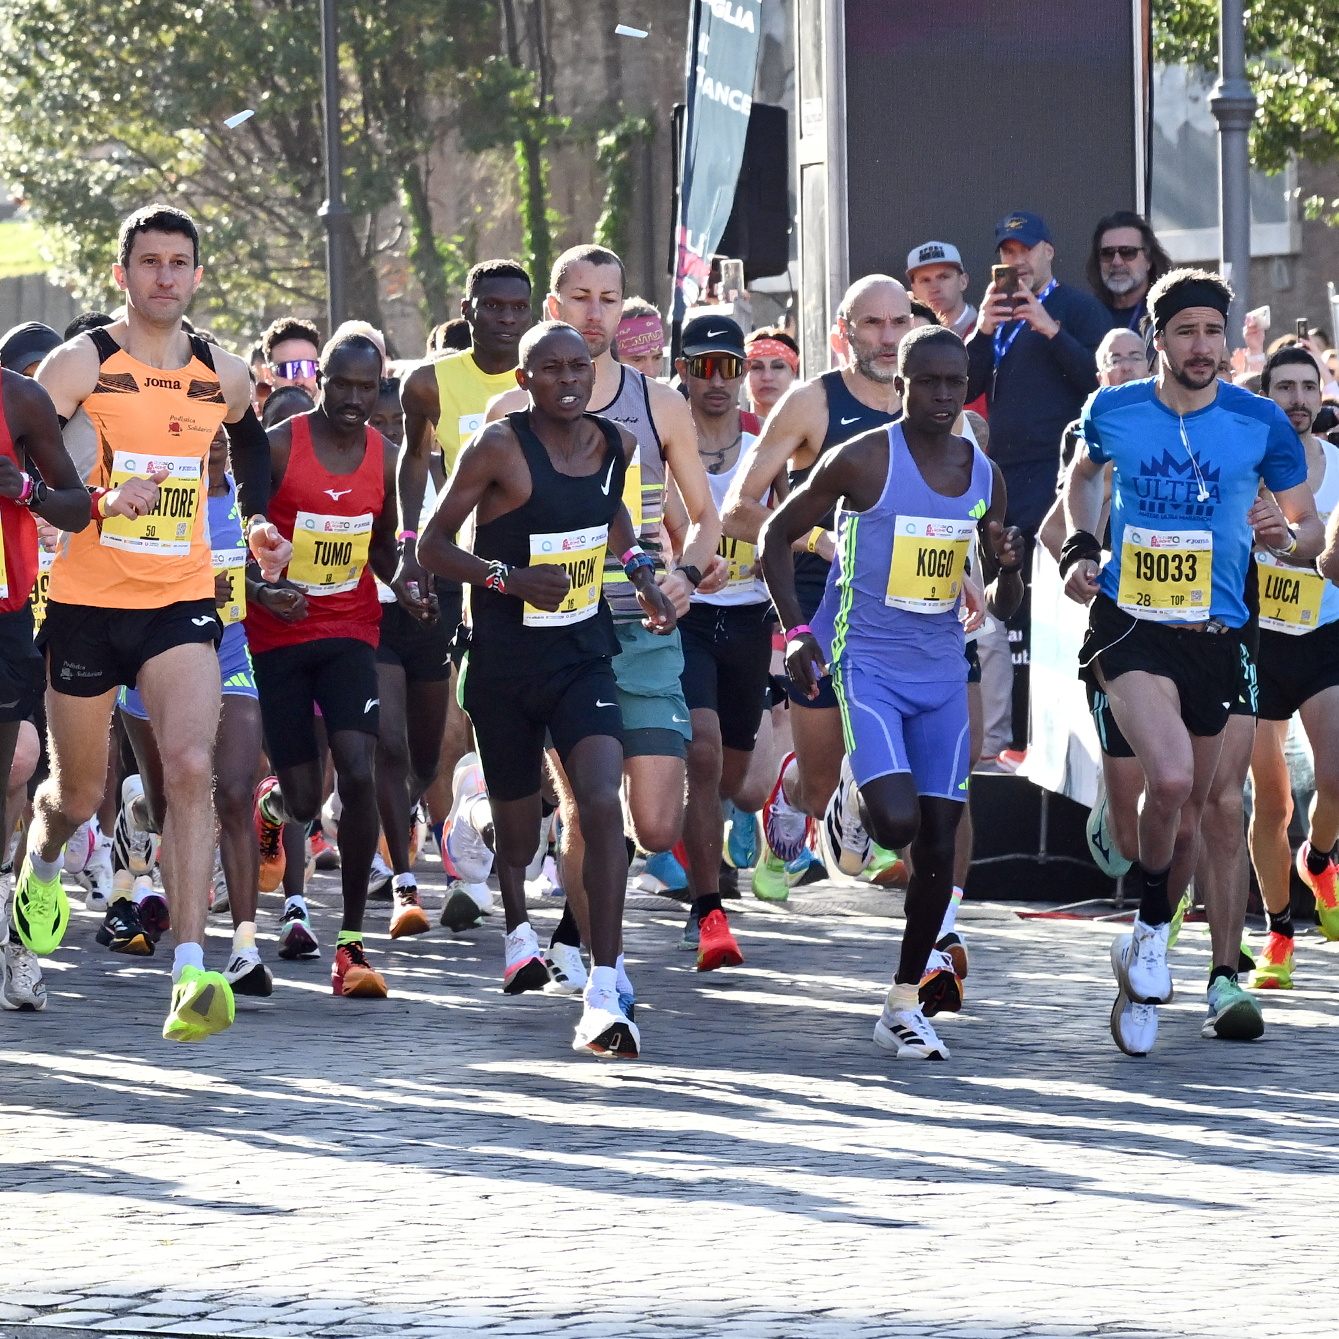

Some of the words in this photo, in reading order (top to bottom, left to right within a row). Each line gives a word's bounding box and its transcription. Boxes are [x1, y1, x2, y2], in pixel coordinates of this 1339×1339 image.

[146, 526, 156, 537] 50
[314, 541, 352, 566] TUMO
[917, 548, 954, 578] KOGO
[1135, 551, 1197, 582] 19033
[1136, 593, 1151, 606] 28
[1171, 595, 1185, 606] TOP
[1265, 575, 1300, 604] LUCA
